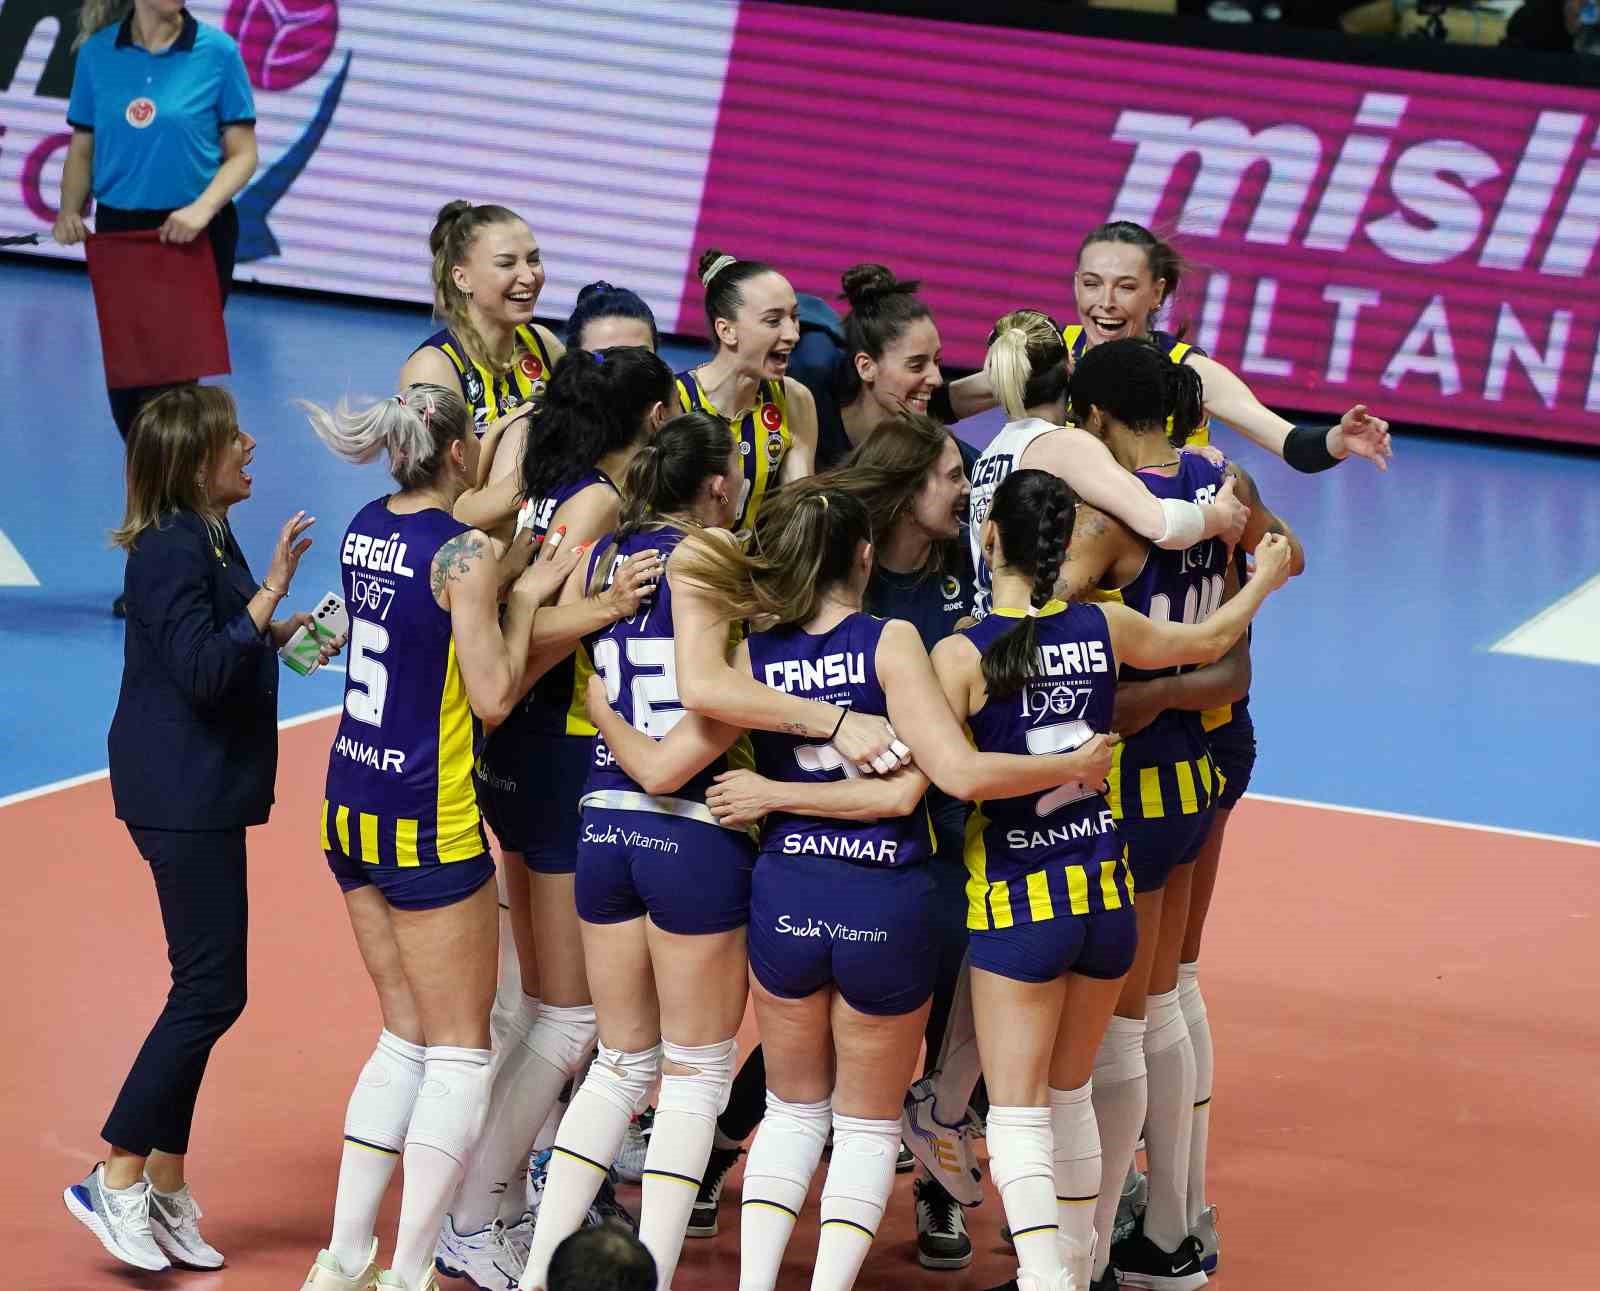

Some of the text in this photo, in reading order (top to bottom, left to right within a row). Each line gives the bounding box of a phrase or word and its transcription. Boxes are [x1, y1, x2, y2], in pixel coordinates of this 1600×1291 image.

[342, 532, 414, 578] ERGÜL
[345, 616, 390, 728] 5
[764, 652, 866, 693] CANSU
[336, 735, 406, 774] ANMAR
[620, 829, 679, 854] Vitamin
[782, 833, 898, 863] SANMAR
[823, 921, 887, 942] Vitamin
